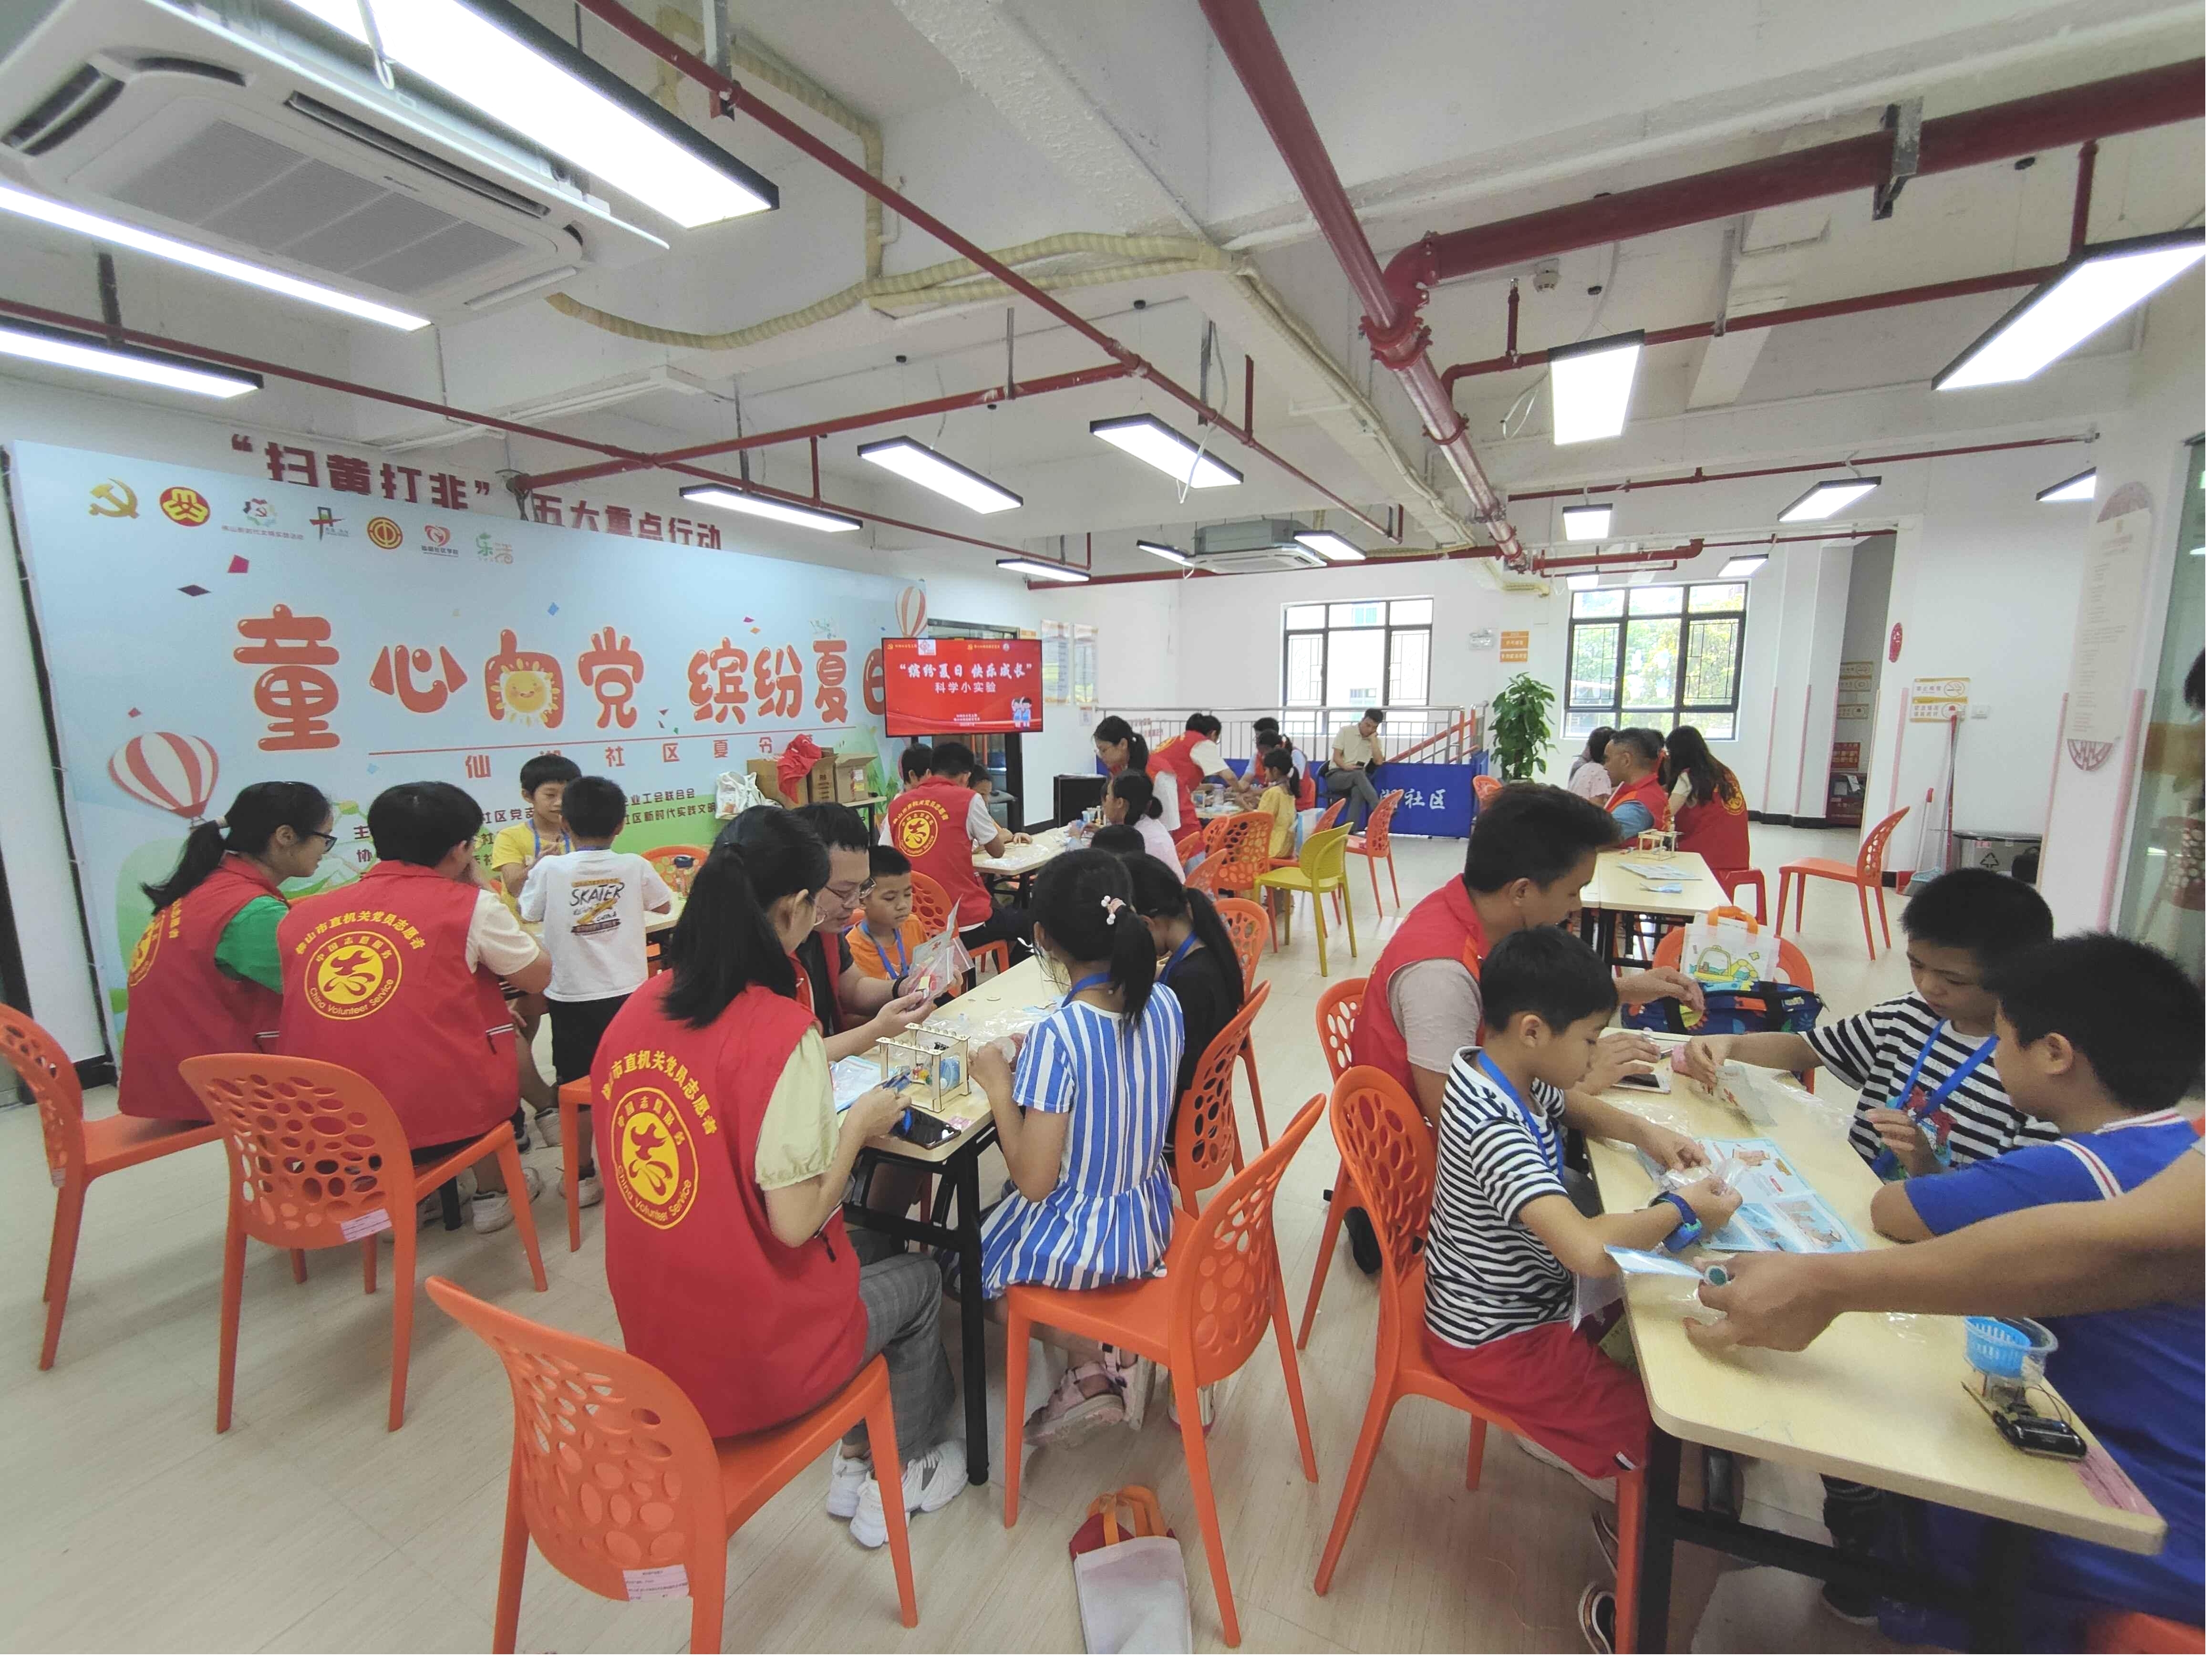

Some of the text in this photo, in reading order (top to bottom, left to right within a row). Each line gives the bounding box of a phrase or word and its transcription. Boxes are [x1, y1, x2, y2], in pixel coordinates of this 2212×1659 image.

[532, 493, 721, 550] 五大重点行动
[233, 603, 644, 751] 童心向党
[935, 682, 996, 694] 科学小实验
[569, 881, 625, 906] SKATER
[310, 978, 393, 1015] China Volunteer Service
[634, 1198, 668, 1222] Volunteer
[668, 1179, 692, 1216] Service
